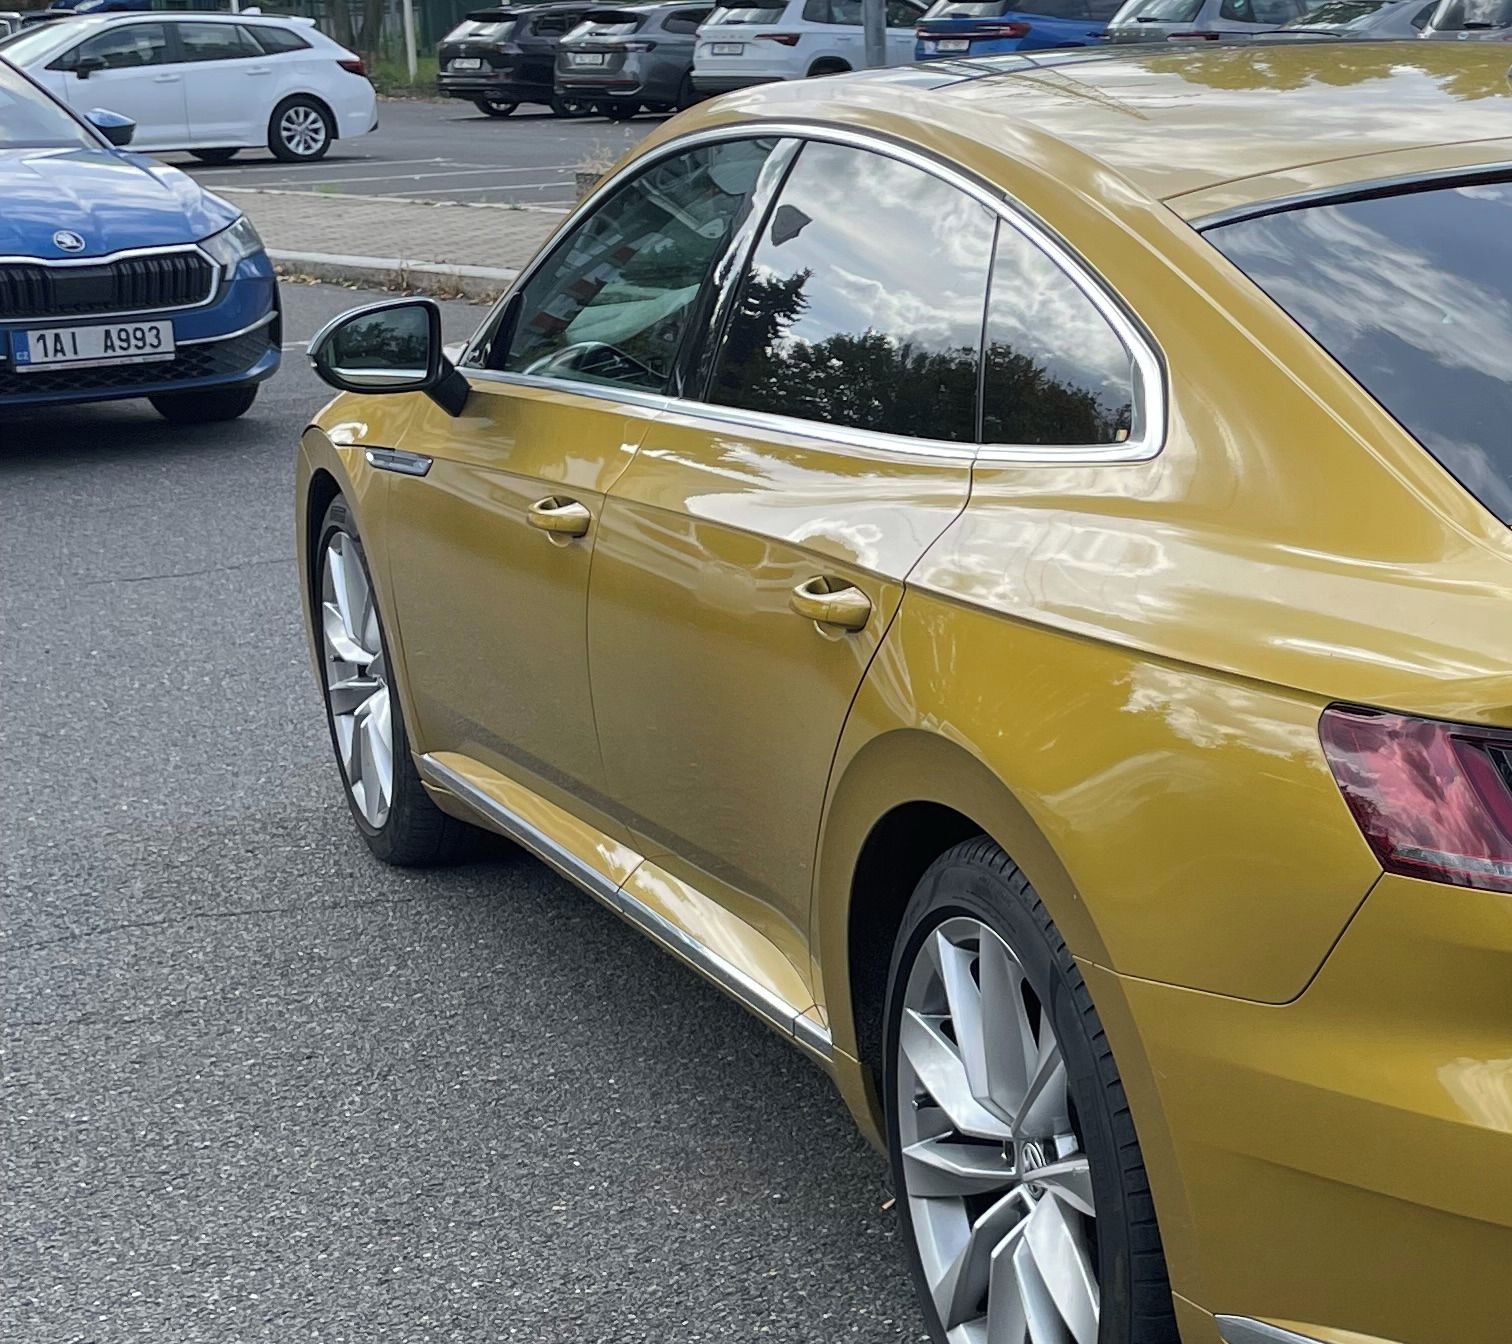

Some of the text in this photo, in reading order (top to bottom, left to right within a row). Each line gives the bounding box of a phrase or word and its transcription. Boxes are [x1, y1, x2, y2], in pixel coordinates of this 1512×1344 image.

[36, 326, 163, 358] 1AI A993
[16, 351, 29, 361] CZ
